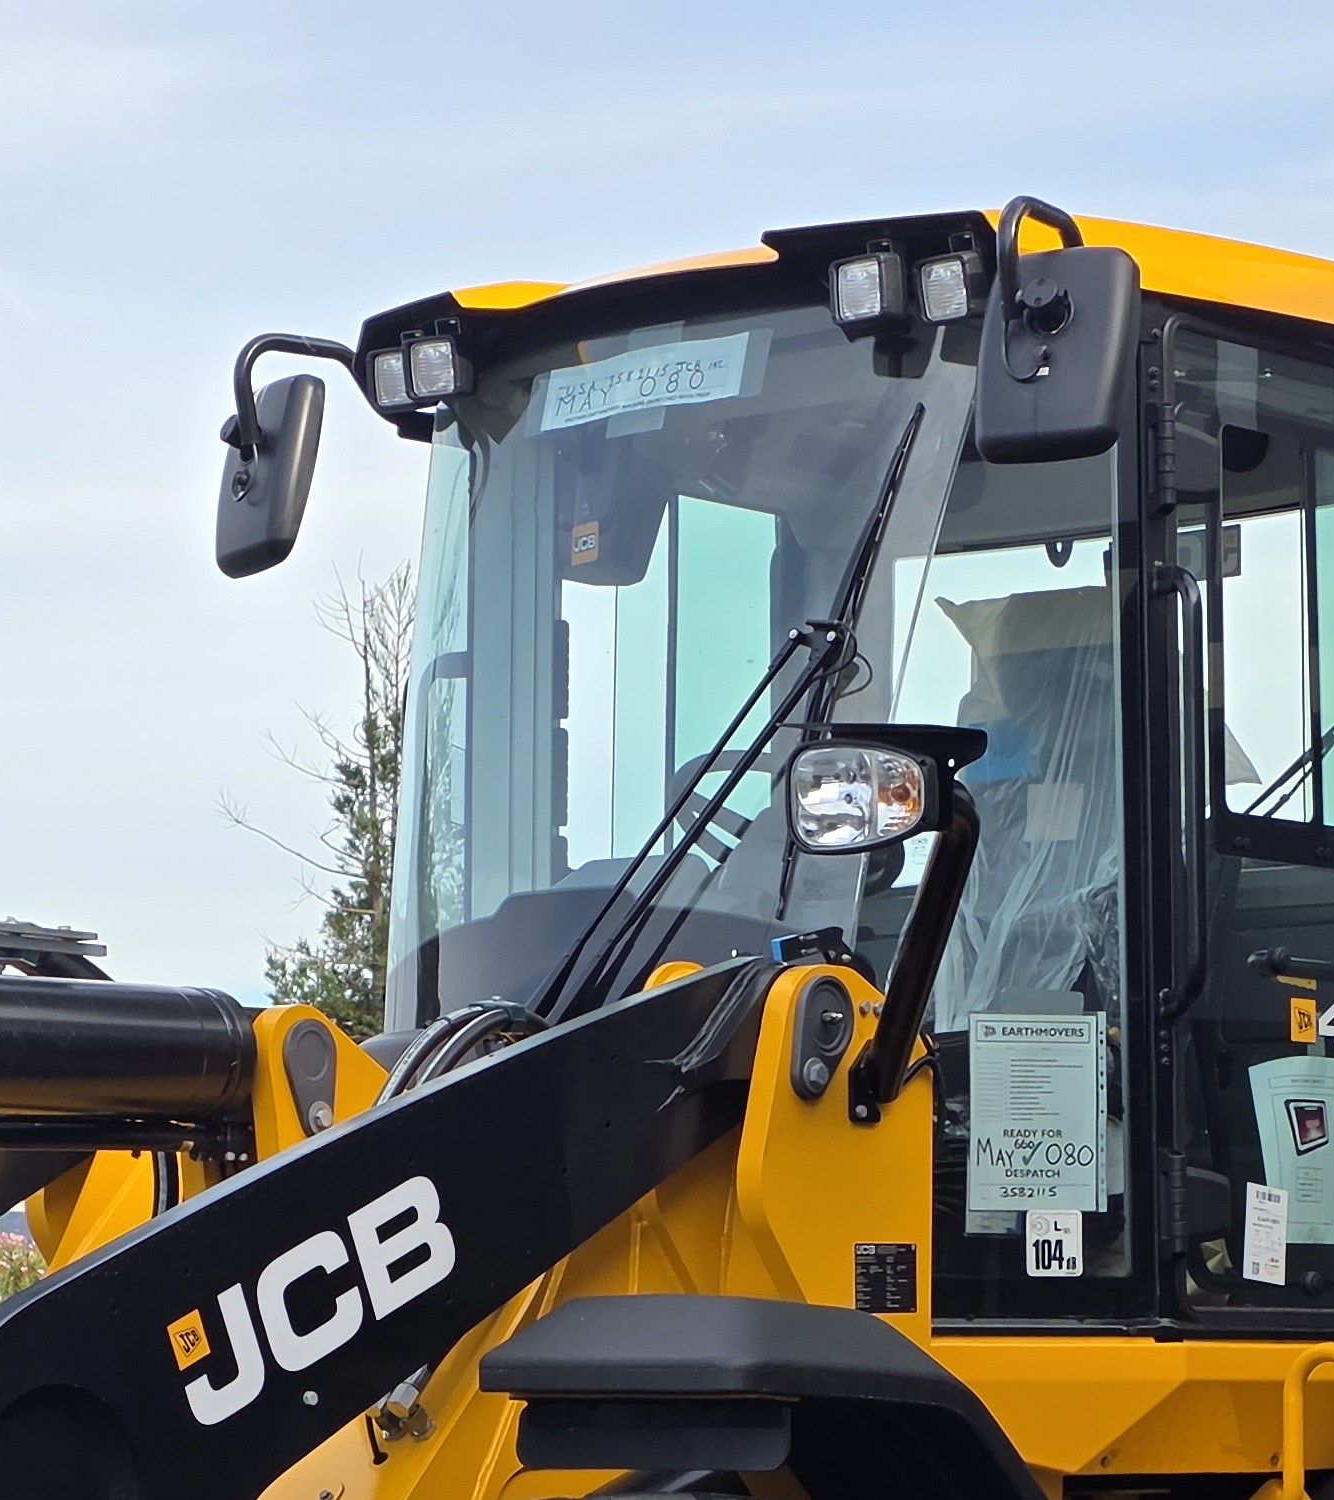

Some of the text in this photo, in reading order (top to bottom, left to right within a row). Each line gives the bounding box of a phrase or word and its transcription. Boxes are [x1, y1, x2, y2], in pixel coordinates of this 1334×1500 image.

[556, 385, 612, 416] MAY
[640, 370, 704, 397] 080
[1001, 1026, 1085, 1038] EARTHMOVERS
[1003, 1129, 1063, 1138] READY FOR
[1046, 1143, 1094, 1166] 080
[1005, 1169, 1061, 1178] DESPATCH
[1000, 1186, 1058, 1197] 3582115
[1033, 1239, 1064, 1270] 104
[185, 1176, 456, 1425] JCB
[179, 1330, 200, 1353] JCB
